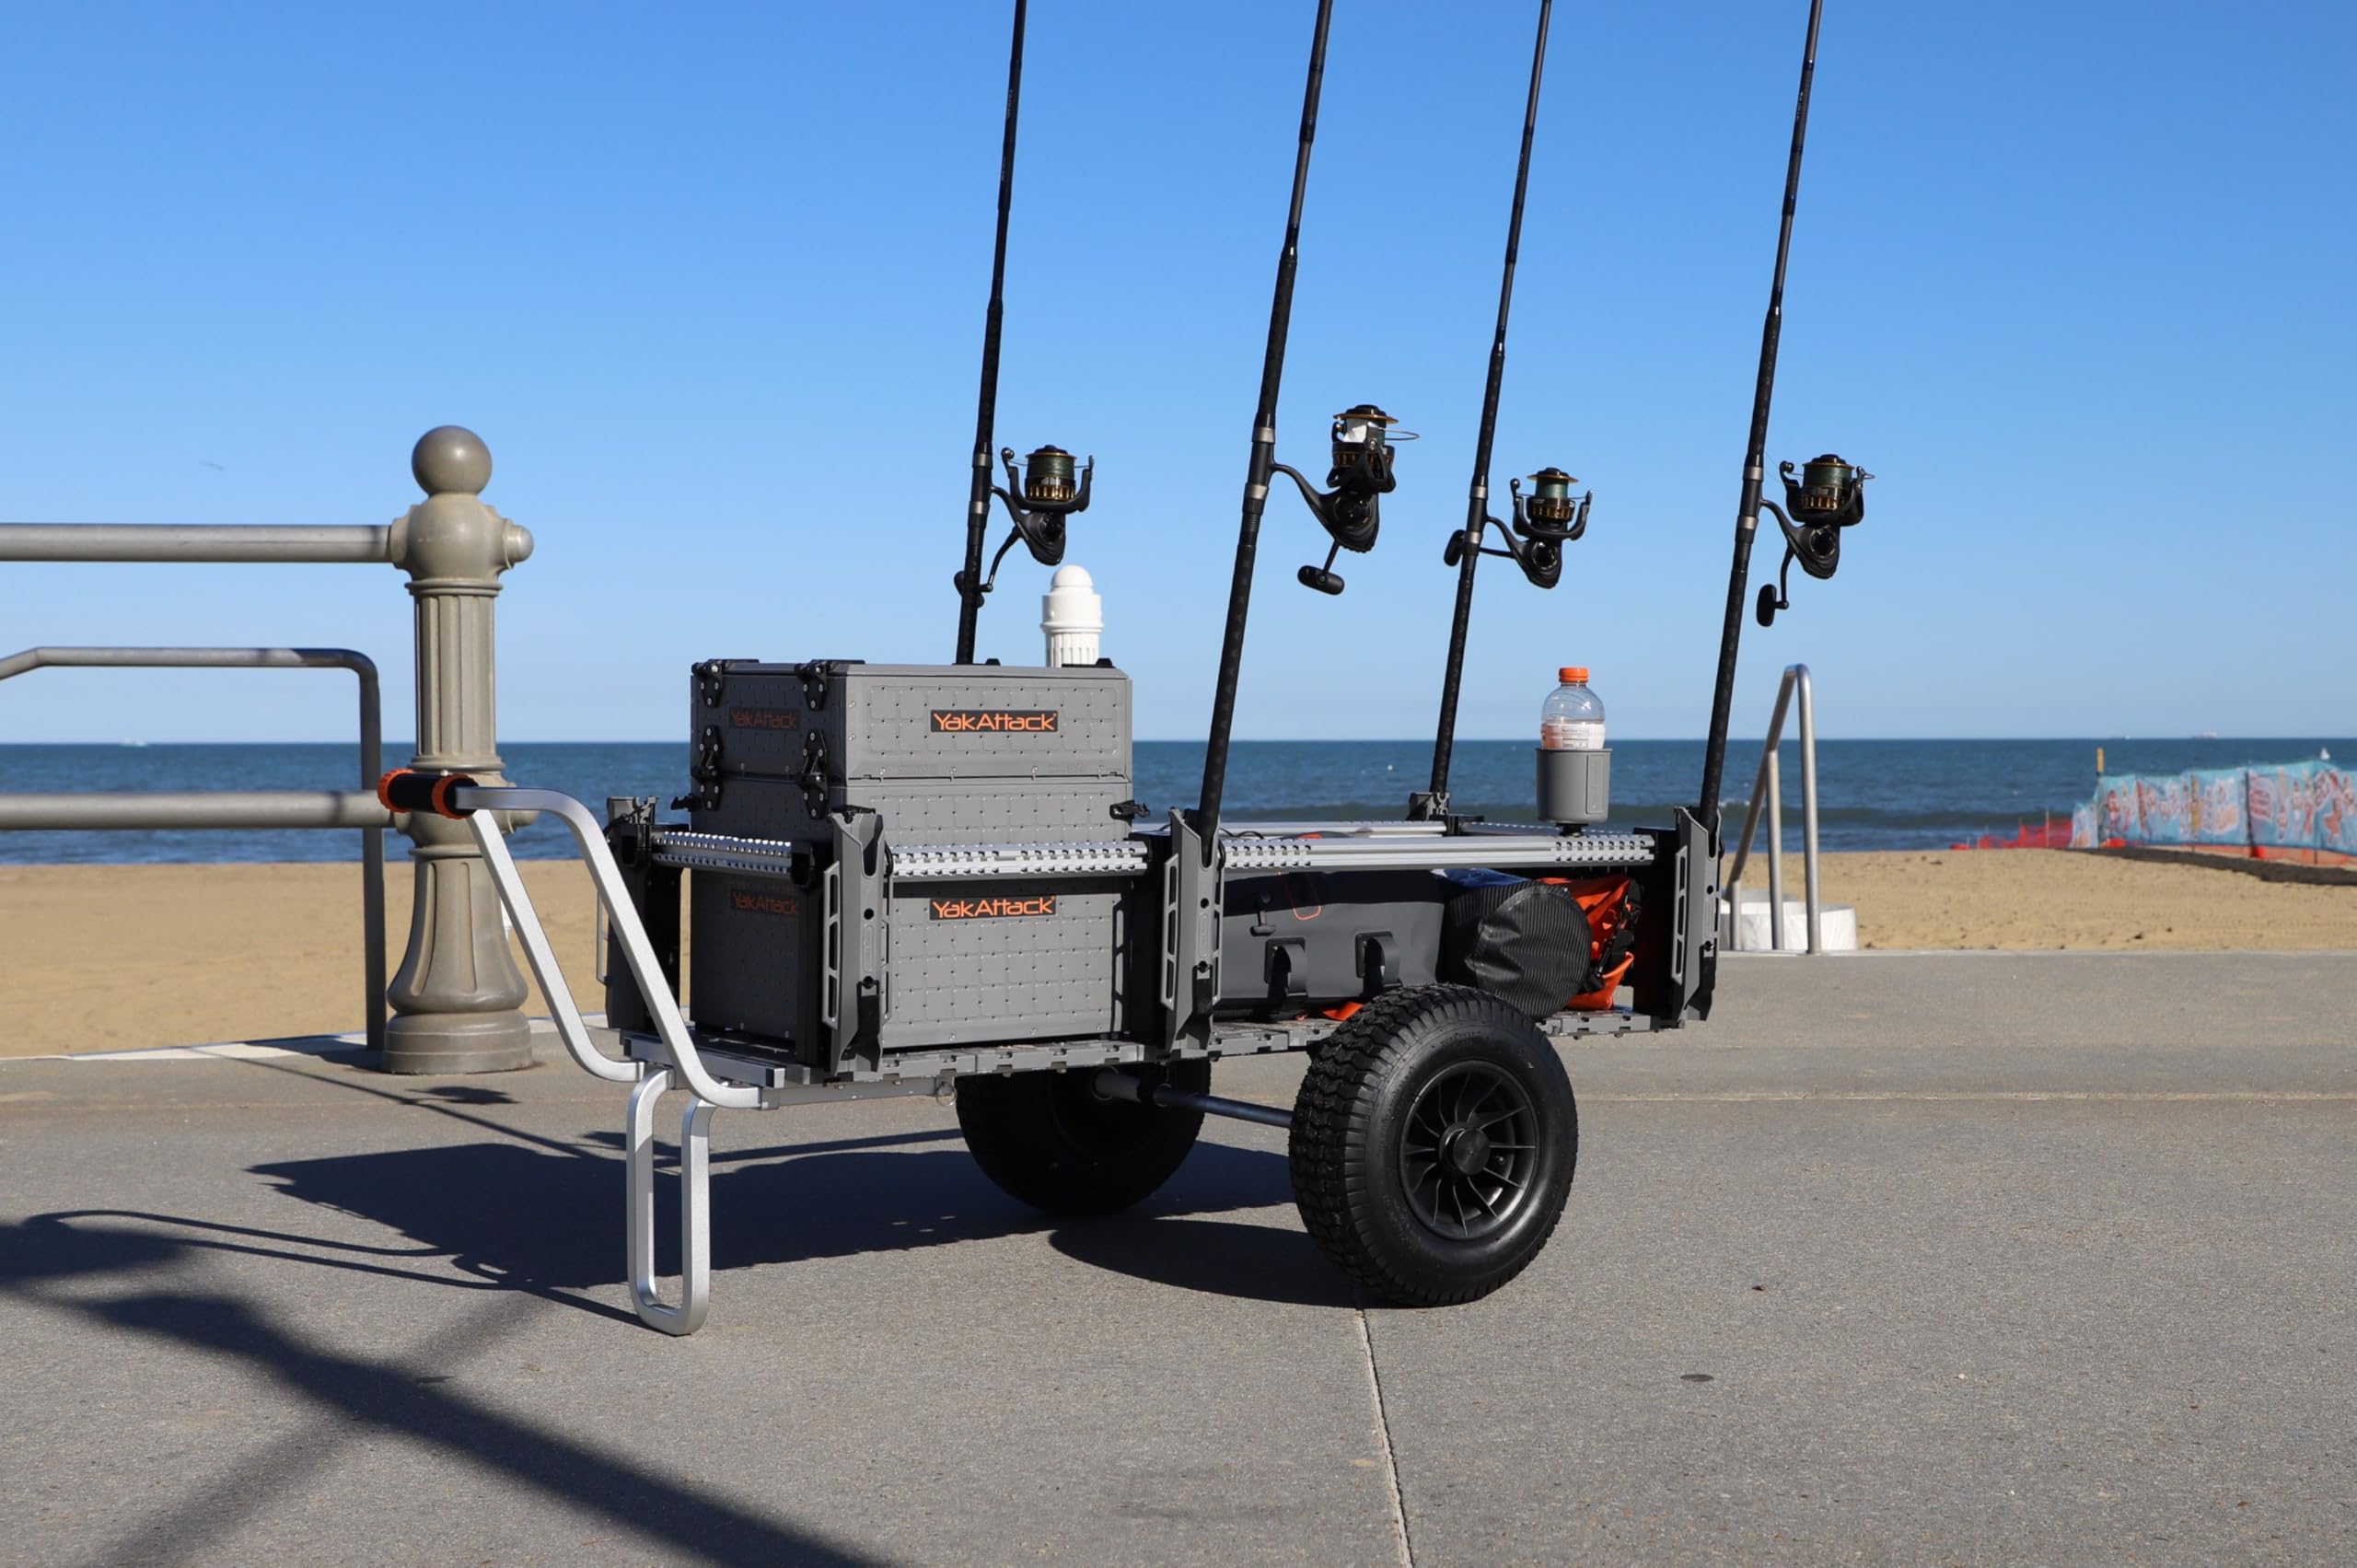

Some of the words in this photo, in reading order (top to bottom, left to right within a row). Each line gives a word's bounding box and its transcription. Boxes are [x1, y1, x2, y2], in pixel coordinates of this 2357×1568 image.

[730, 710, 796, 728] YakAttack
[934, 713, 1055, 731] YakAttack
[933, 897, 1053, 919] YakAttack
